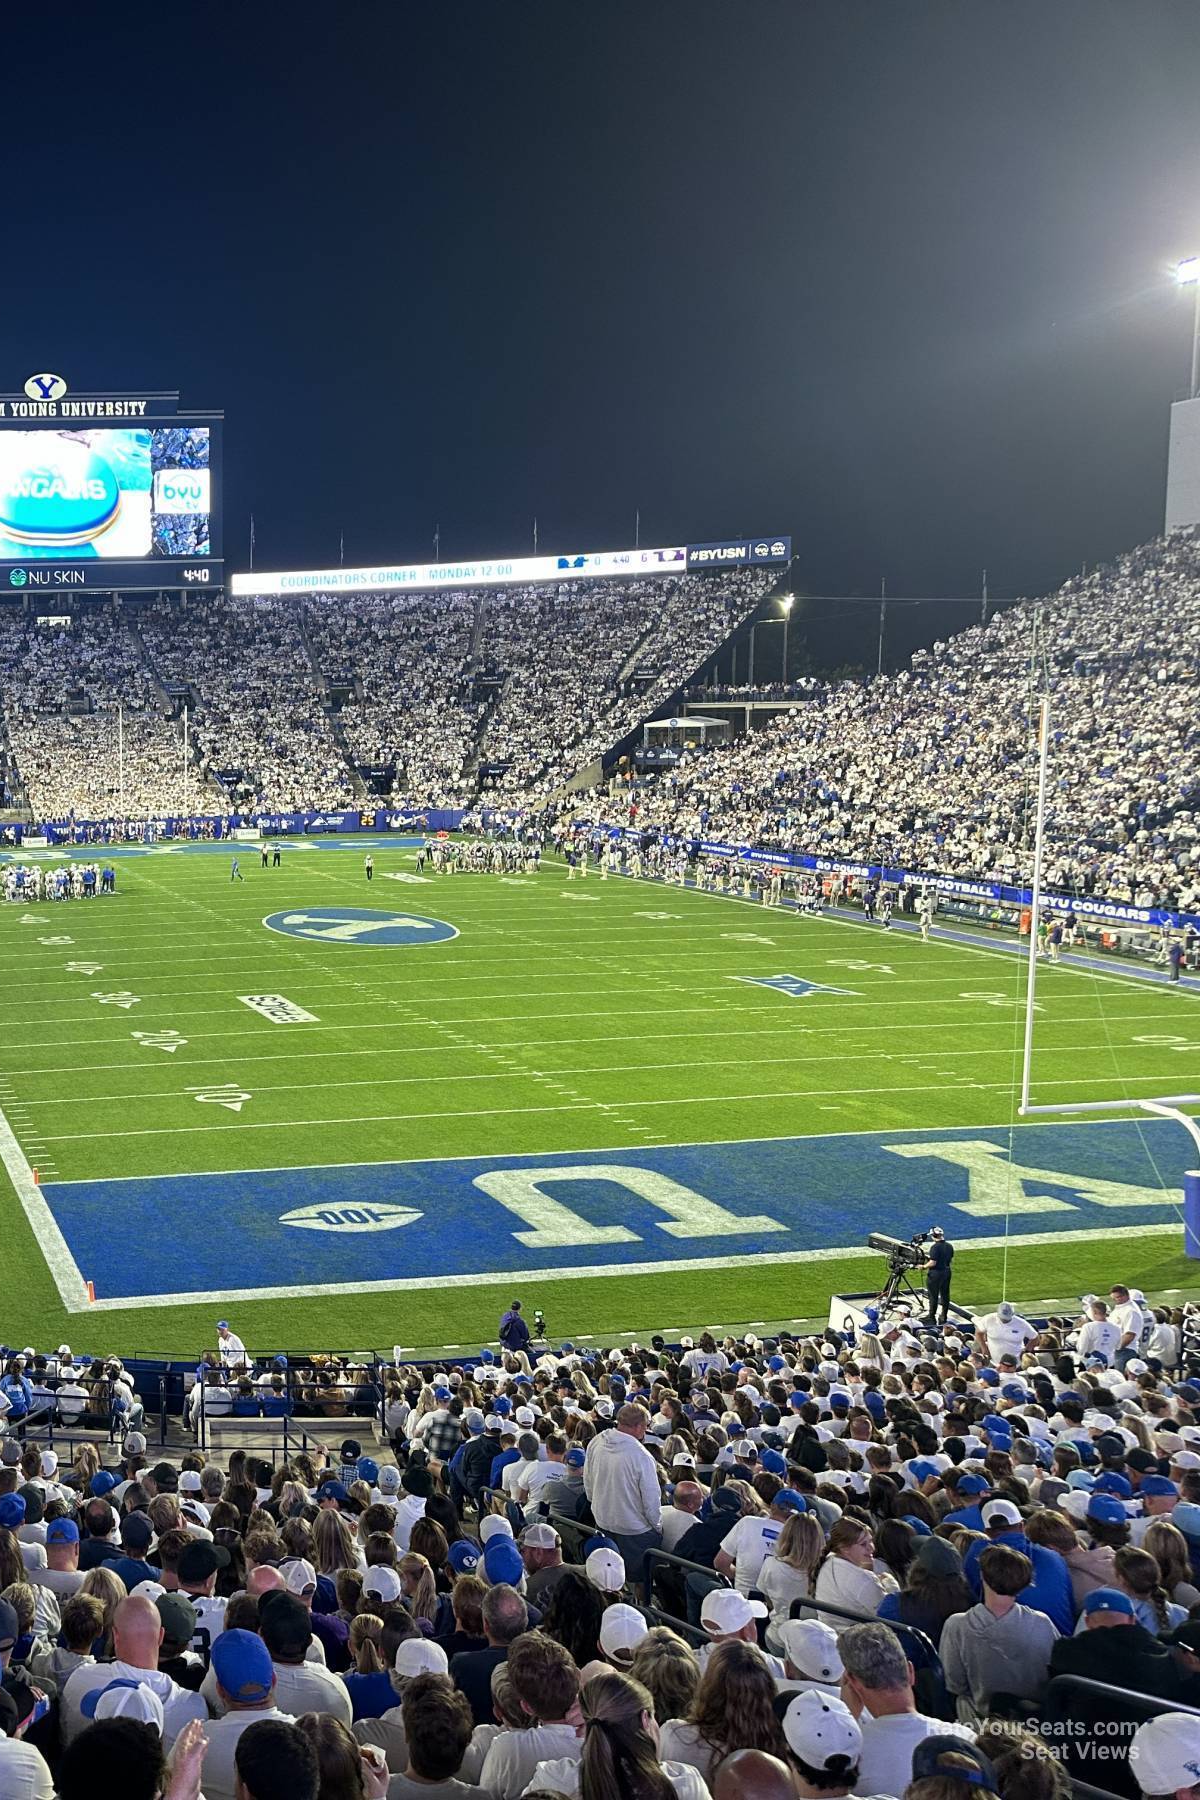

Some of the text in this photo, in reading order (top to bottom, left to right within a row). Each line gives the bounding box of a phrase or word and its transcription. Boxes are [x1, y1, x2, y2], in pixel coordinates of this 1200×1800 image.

[32, 377, 59, 399] Y
[11, 402, 57, 417] YOUNG
[61, 401, 147, 416] UNIVERSITY
[690, 547, 746, 561] #BYUSN
[29, 570, 85, 584] NU SKIN
[184, 569, 210, 582] 4:40
[280, 572, 368, 588] COORDINATORS
[370, 570, 417, 583] CORNER
[428, 567, 476, 580] MONDAY
[361, 815, 374, 826] 25
[816, 861, 869, 878] GO COUGS
[928, 877, 994, 897] FOOTBALL
[1039, 895, 1151, 922] BYU COUGARS
[89, 991, 142, 1004] 30
[130, 1029, 189, 1047] 20
[183, 1083, 253, 1103] 10
[472, 1164, 790, 1248] U
